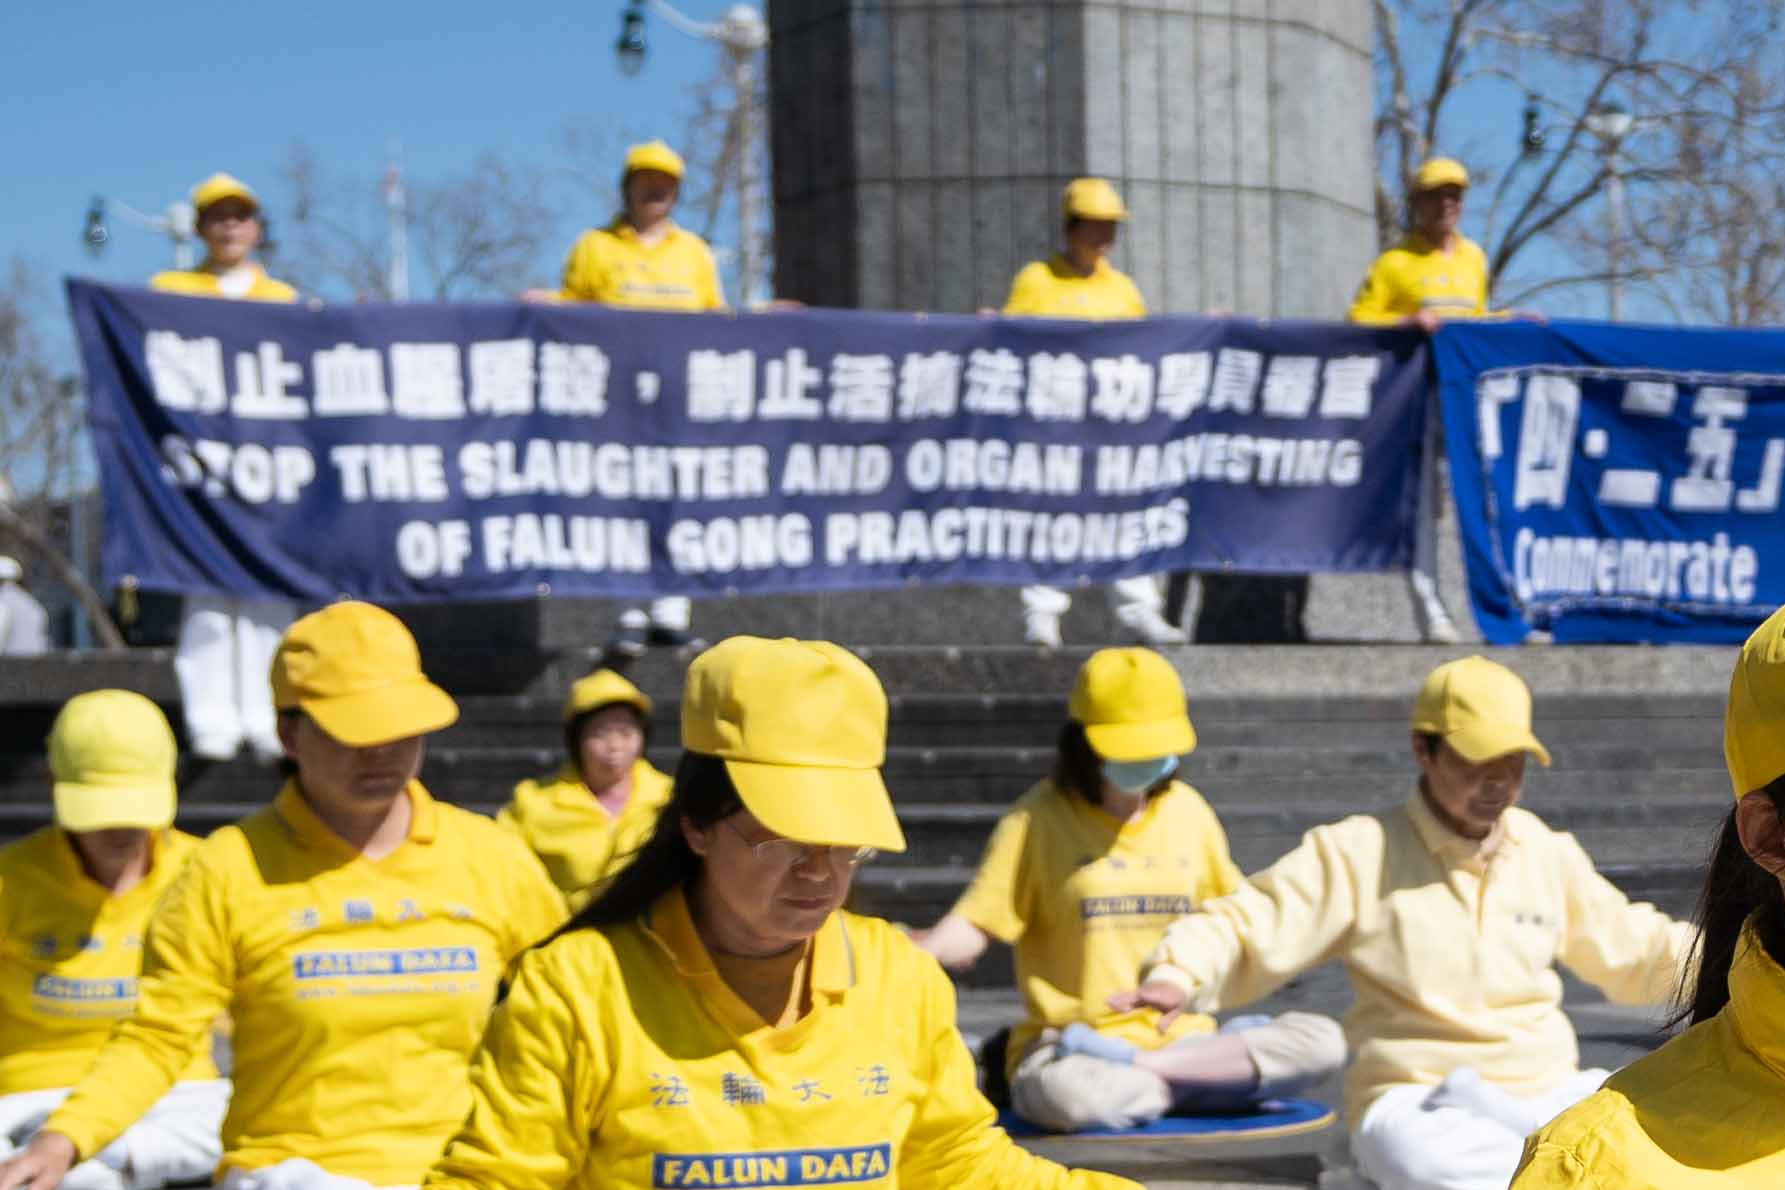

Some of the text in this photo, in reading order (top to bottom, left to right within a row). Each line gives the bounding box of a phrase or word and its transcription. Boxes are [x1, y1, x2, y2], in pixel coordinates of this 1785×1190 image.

[161, 432, 1363, 505] STOP THE SLAUGHTER AND ORGAN HARVESTING
[395, 498, 1189, 579] OF FALUN GONG PRACTITIONERS
[1513, 526, 1758, 604] Commemorate
[662, 1149, 887, 1185] FALUN DAFA
